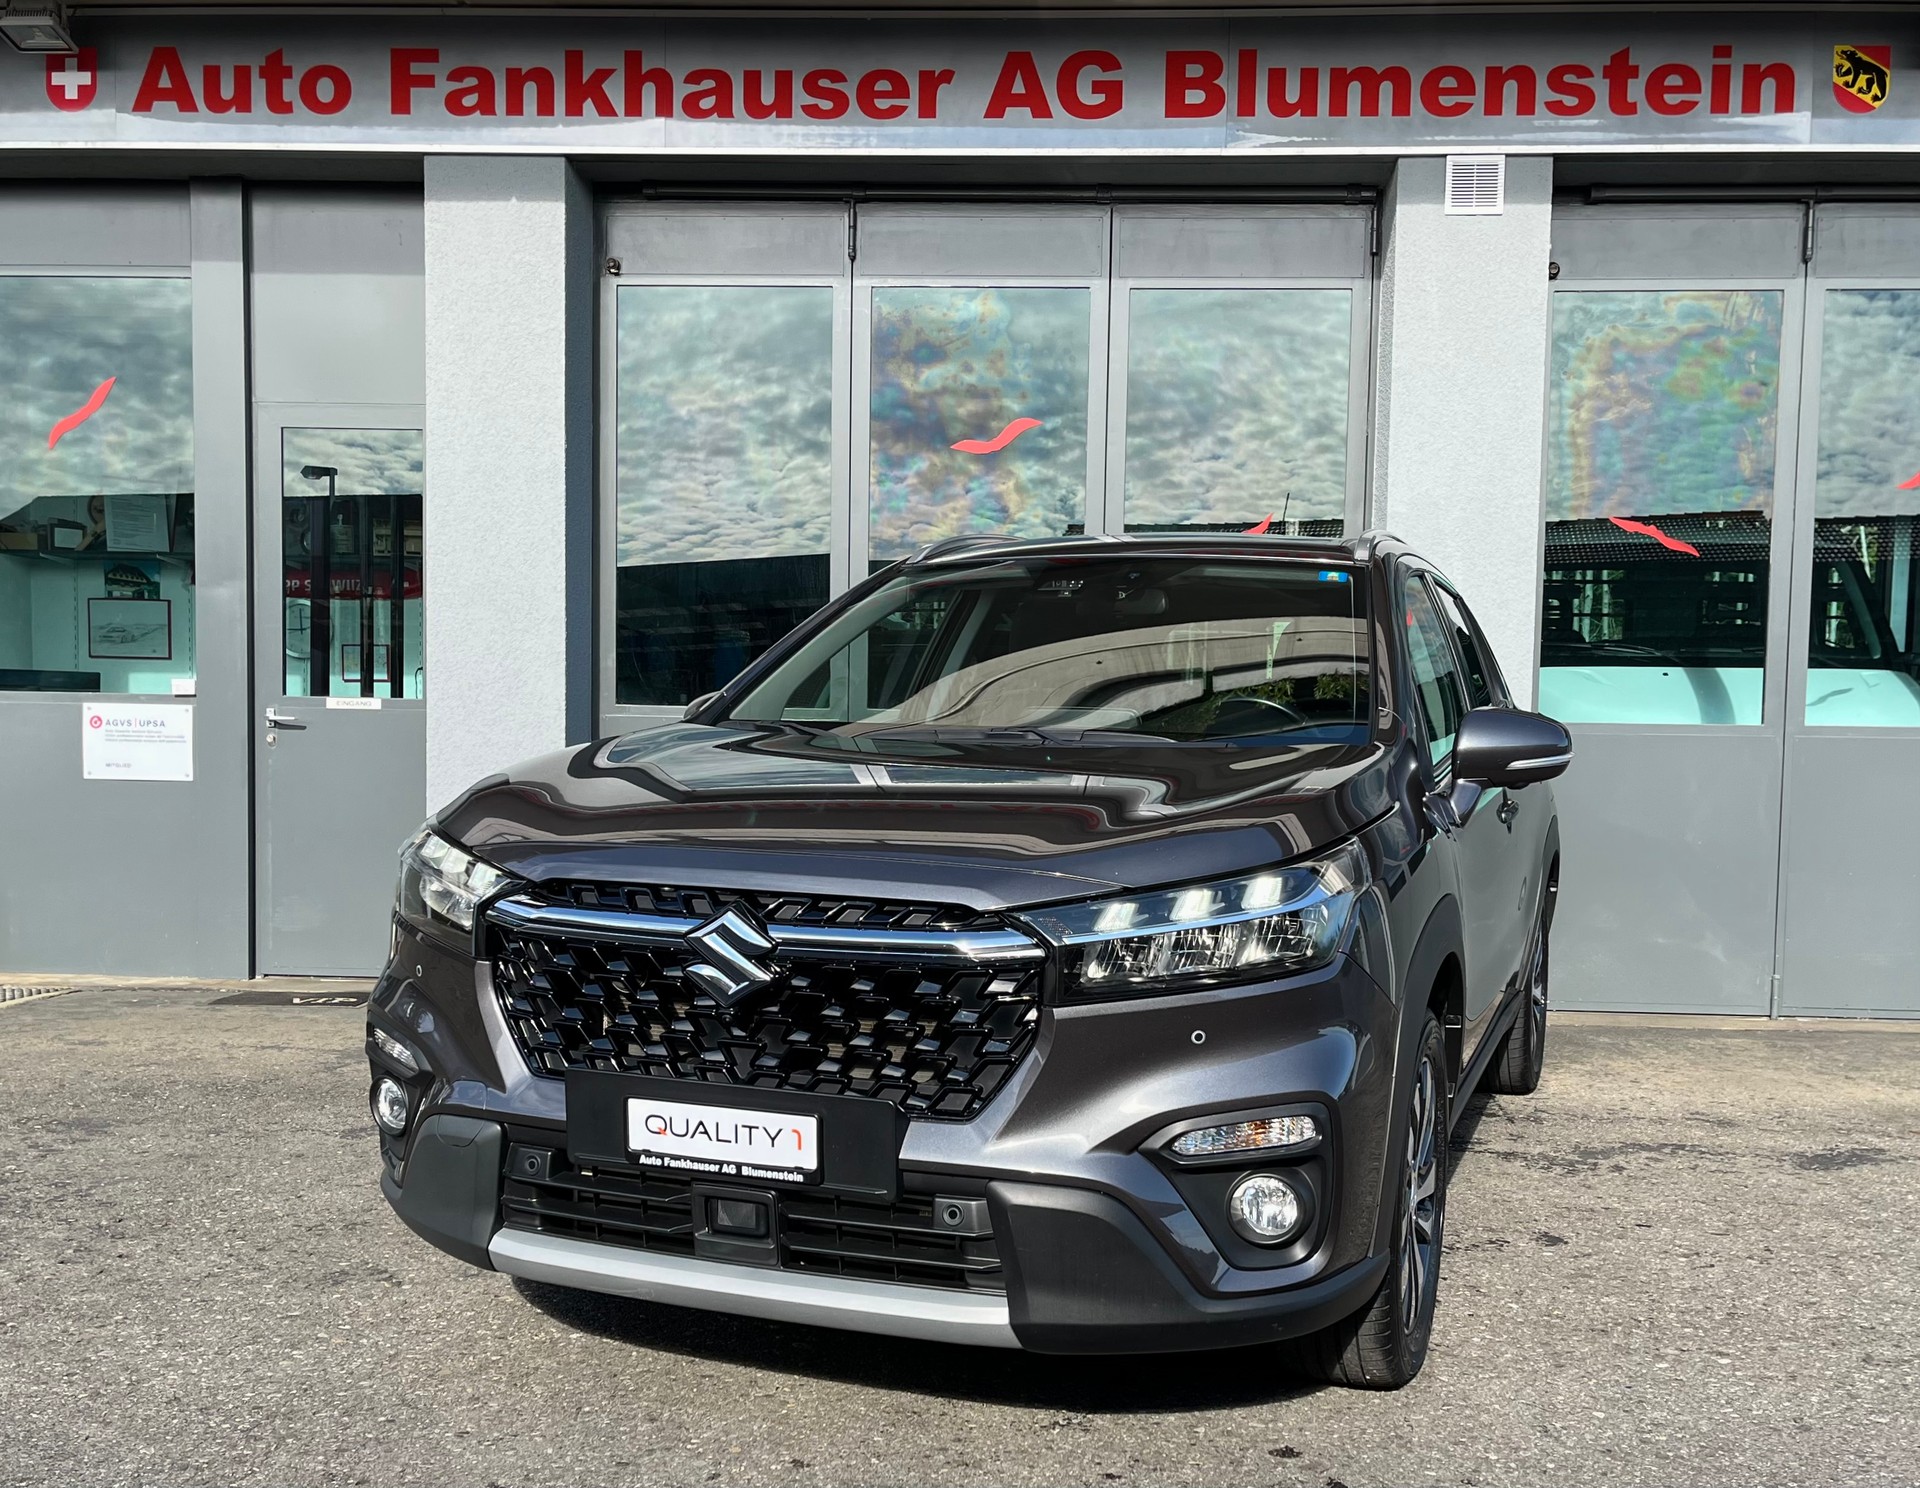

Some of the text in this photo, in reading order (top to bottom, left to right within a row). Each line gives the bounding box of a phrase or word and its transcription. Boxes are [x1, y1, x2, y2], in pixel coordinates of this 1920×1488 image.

[134, 48, 1795, 119] Auto Fankhauser AG Blumenstein
[644, 1114, 802, 1151] QUALITY 1
[639, 1154, 804, 1182] Auto Fankhauser AG Blumenstein
